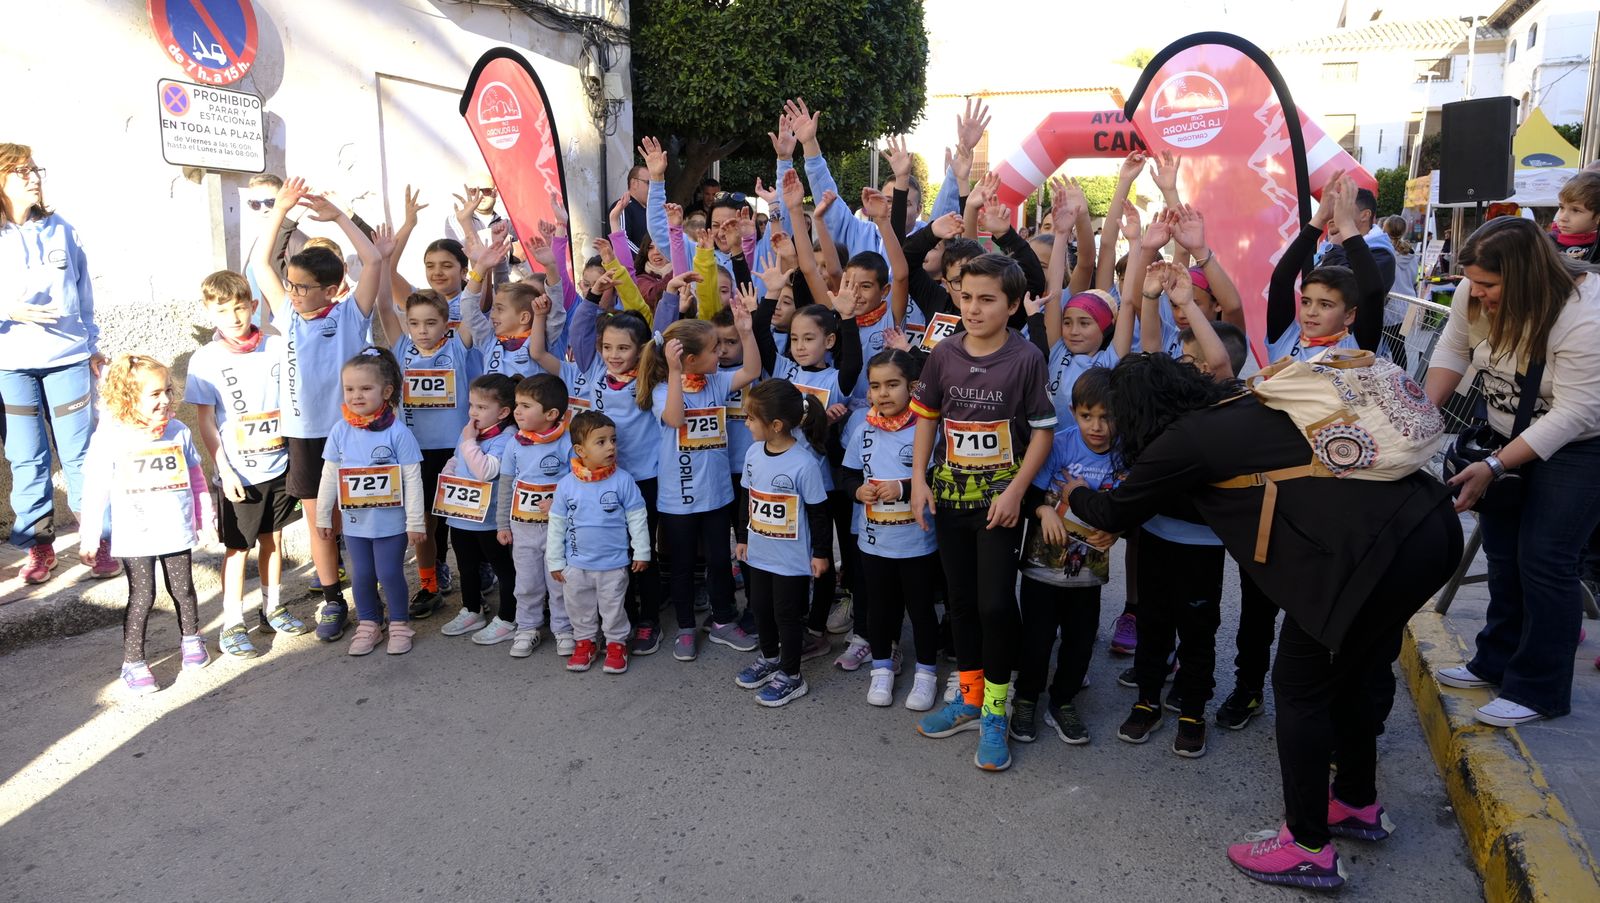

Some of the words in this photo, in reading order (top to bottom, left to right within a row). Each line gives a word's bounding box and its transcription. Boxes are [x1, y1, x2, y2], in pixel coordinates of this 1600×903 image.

[168, 44, 184, 63] de
[186, 62, 196, 71] 7
[198, 68, 211, 82] h.
[214, 74, 222, 83] a
[224, 67, 239, 81] 15
[237, 61, 250, 73] h.
[194, 89, 259, 109] PROHIBIDO
[209, 104, 239, 115] PARAR
[1092, 112, 1126, 124] AYU
[200, 112, 256, 126] ESTACIONAR
[163, 119, 177, 129] EN
[181, 122, 211, 134] TODA
[214, 127, 227, 136] LA
[230, 129, 262, 141] PLAZA
[185, 136, 212, 146] Viernes
[1094, 130, 1146, 151] CAN
[934, 322, 955, 337] 75
[222, 368, 238, 387] LA
[410, 378, 444, 391] 702
[244, 418, 278, 436] 747
[688, 416, 718, 432] 725
[863, 430, 875, 448] LA
[954, 432, 998, 450] 710
[134, 456, 177, 473] 748
[348, 476, 388, 491] 727
[678, 451, 694, 505] ORILLA
[446, 485, 480, 503] 732
[752, 500, 786, 519] 749
